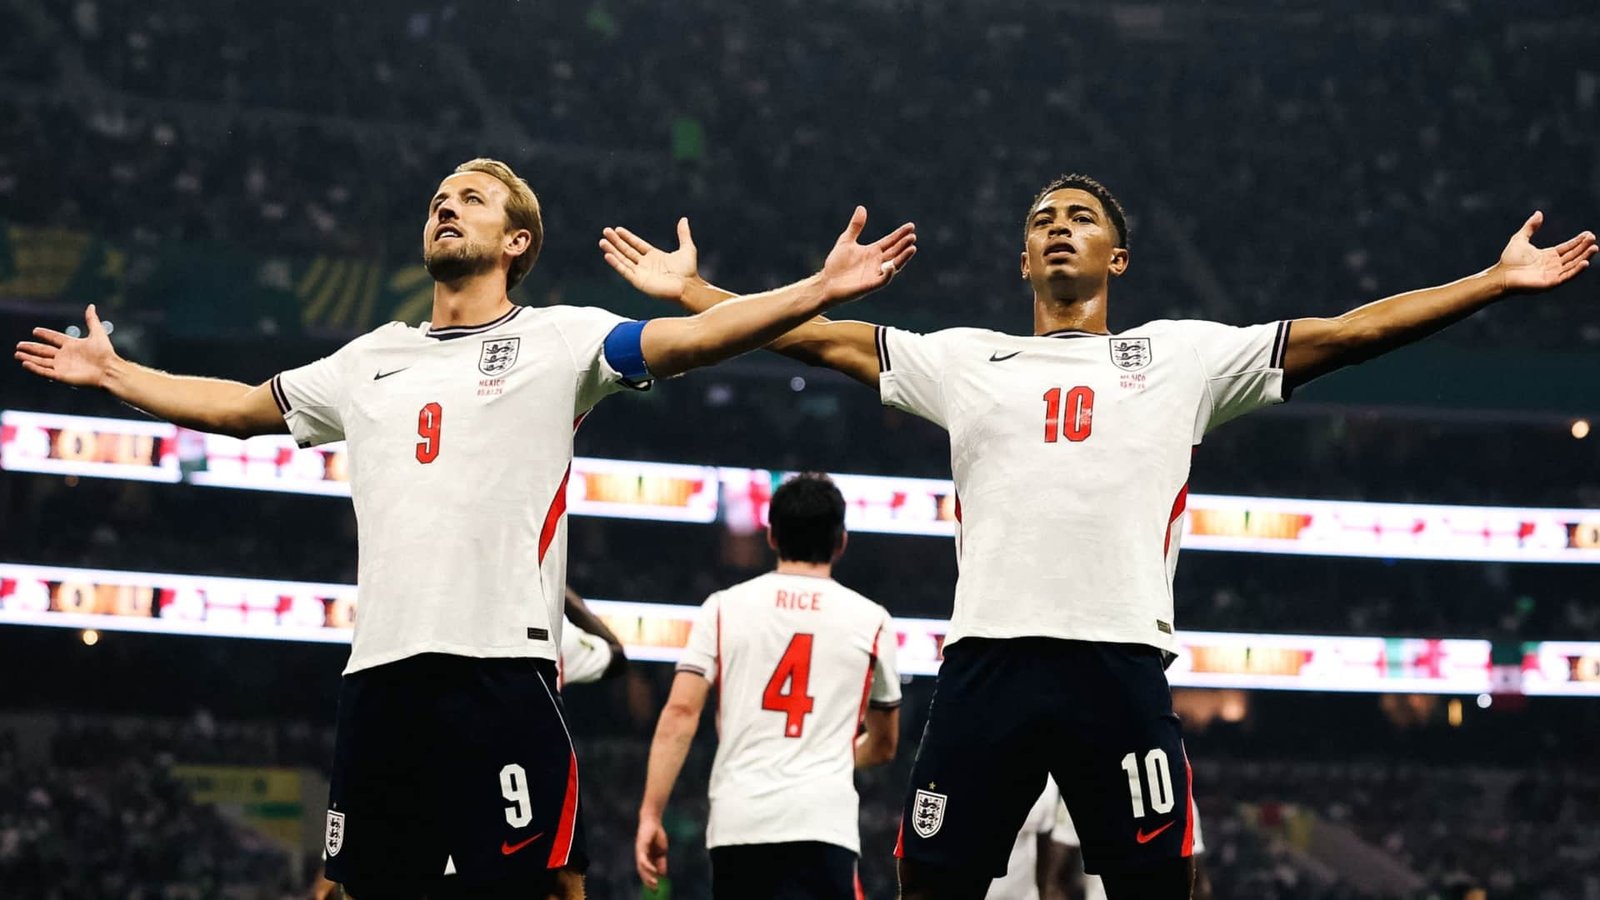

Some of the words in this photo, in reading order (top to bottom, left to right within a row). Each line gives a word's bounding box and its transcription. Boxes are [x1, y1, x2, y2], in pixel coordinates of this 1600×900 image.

[415, 402, 443, 464] 9
[1043, 385, 1095, 443] 10
[776, 590, 823, 611] RICE
[762, 632, 815, 738] 4
[499, 763, 533, 829] 9
[1121, 748, 1175, 819] 10
